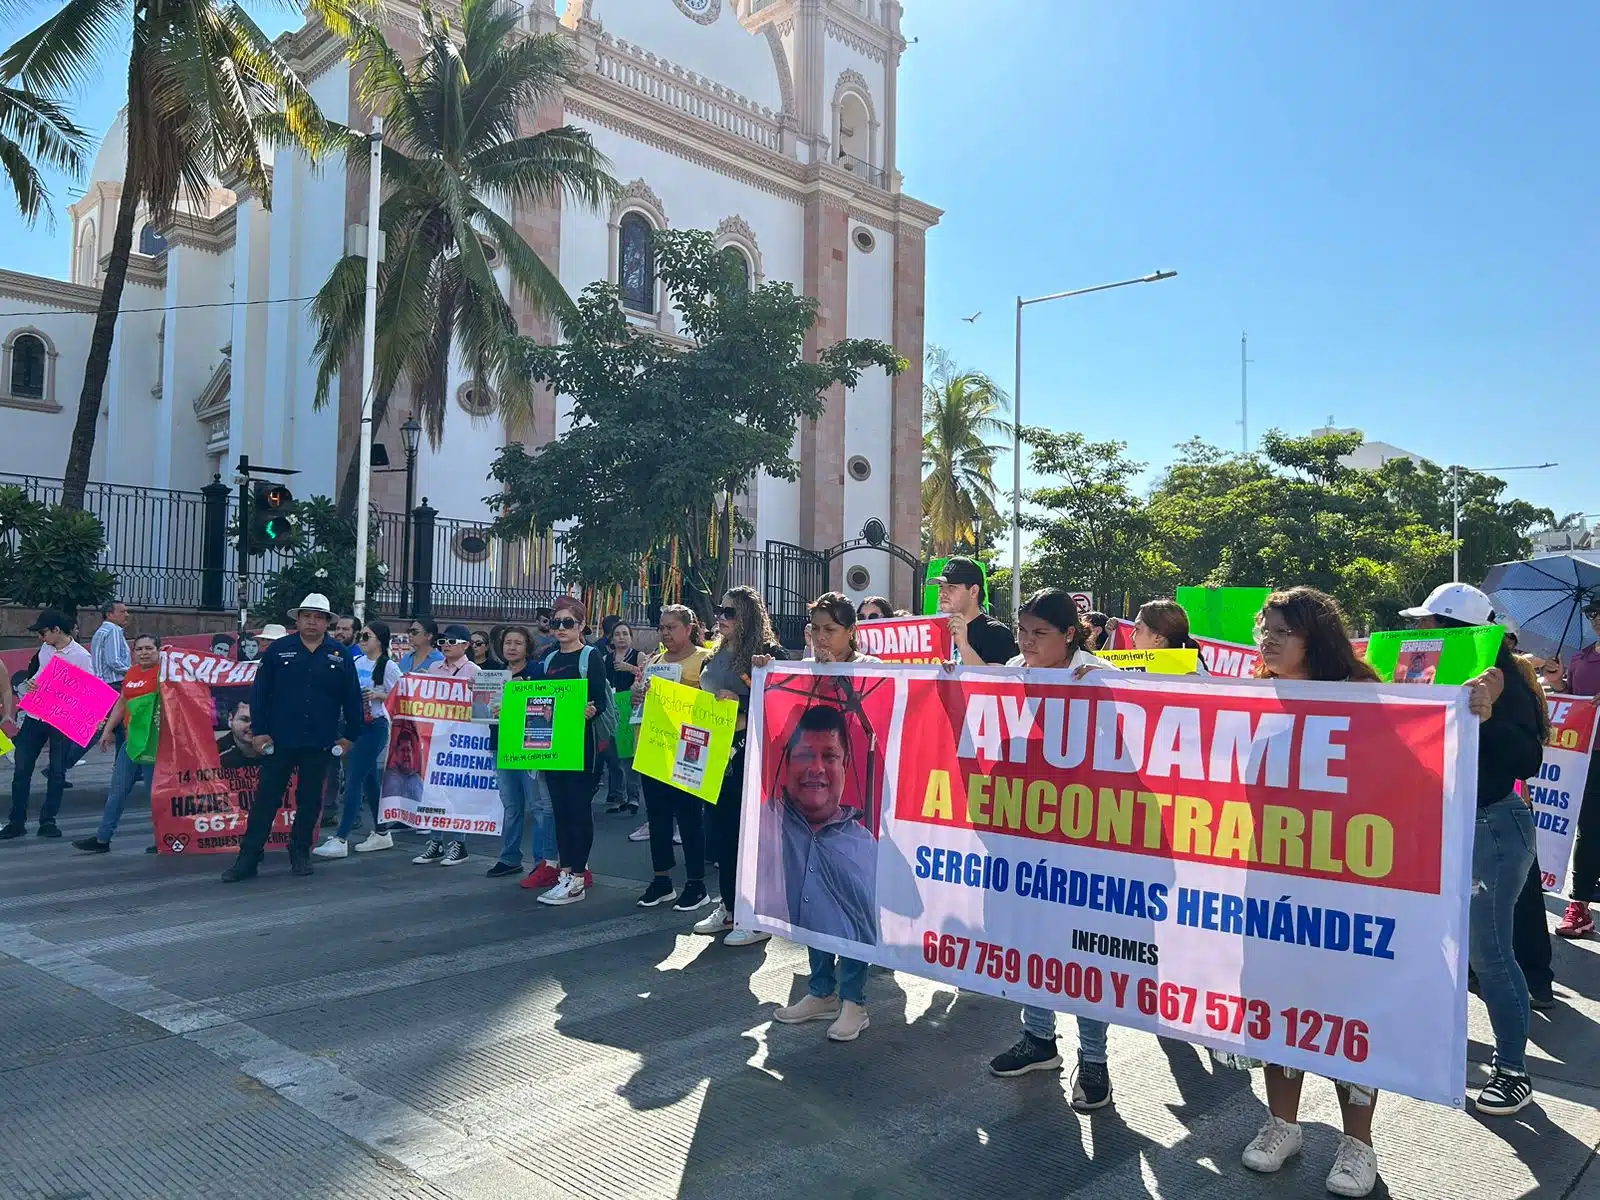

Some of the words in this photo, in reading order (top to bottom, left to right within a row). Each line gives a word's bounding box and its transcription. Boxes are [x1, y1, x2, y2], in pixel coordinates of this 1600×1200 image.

[957, 693, 1350, 794] AYUDAME
[196, 767, 241, 781] OCTUBRE
[194, 813, 239, 833] 667
[416, 805, 446, 815] INFORMES
[424, 815, 431, 827] Y
[432, 816, 450, 829] 667
[453, 818, 471, 831] 573
[473, 820, 497, 832] 1276
[920, 769, 953, 821] A
[965, 775, 1393, 878] ENCONTRARLO
[915, 844, 1009, 892] SERGIO
[1014, 857, 1168, 922] CÁRDENAS
[1177, 886, 1395, 960] HERNÁNDEZ
[1072, 928, 1159, 966] INFORMES
[922, 930, 971, 971] 667
[975, 940, 1021, 983] 759
[1026, 952, 1102, 1003] 0900
[1107, 973, 1131, 1003] Y
[1136, 981, 1199, 1028] 667
[1205, 992, 1271, 1041] 573
[1281, 1006, 1369, 1064] 1276
